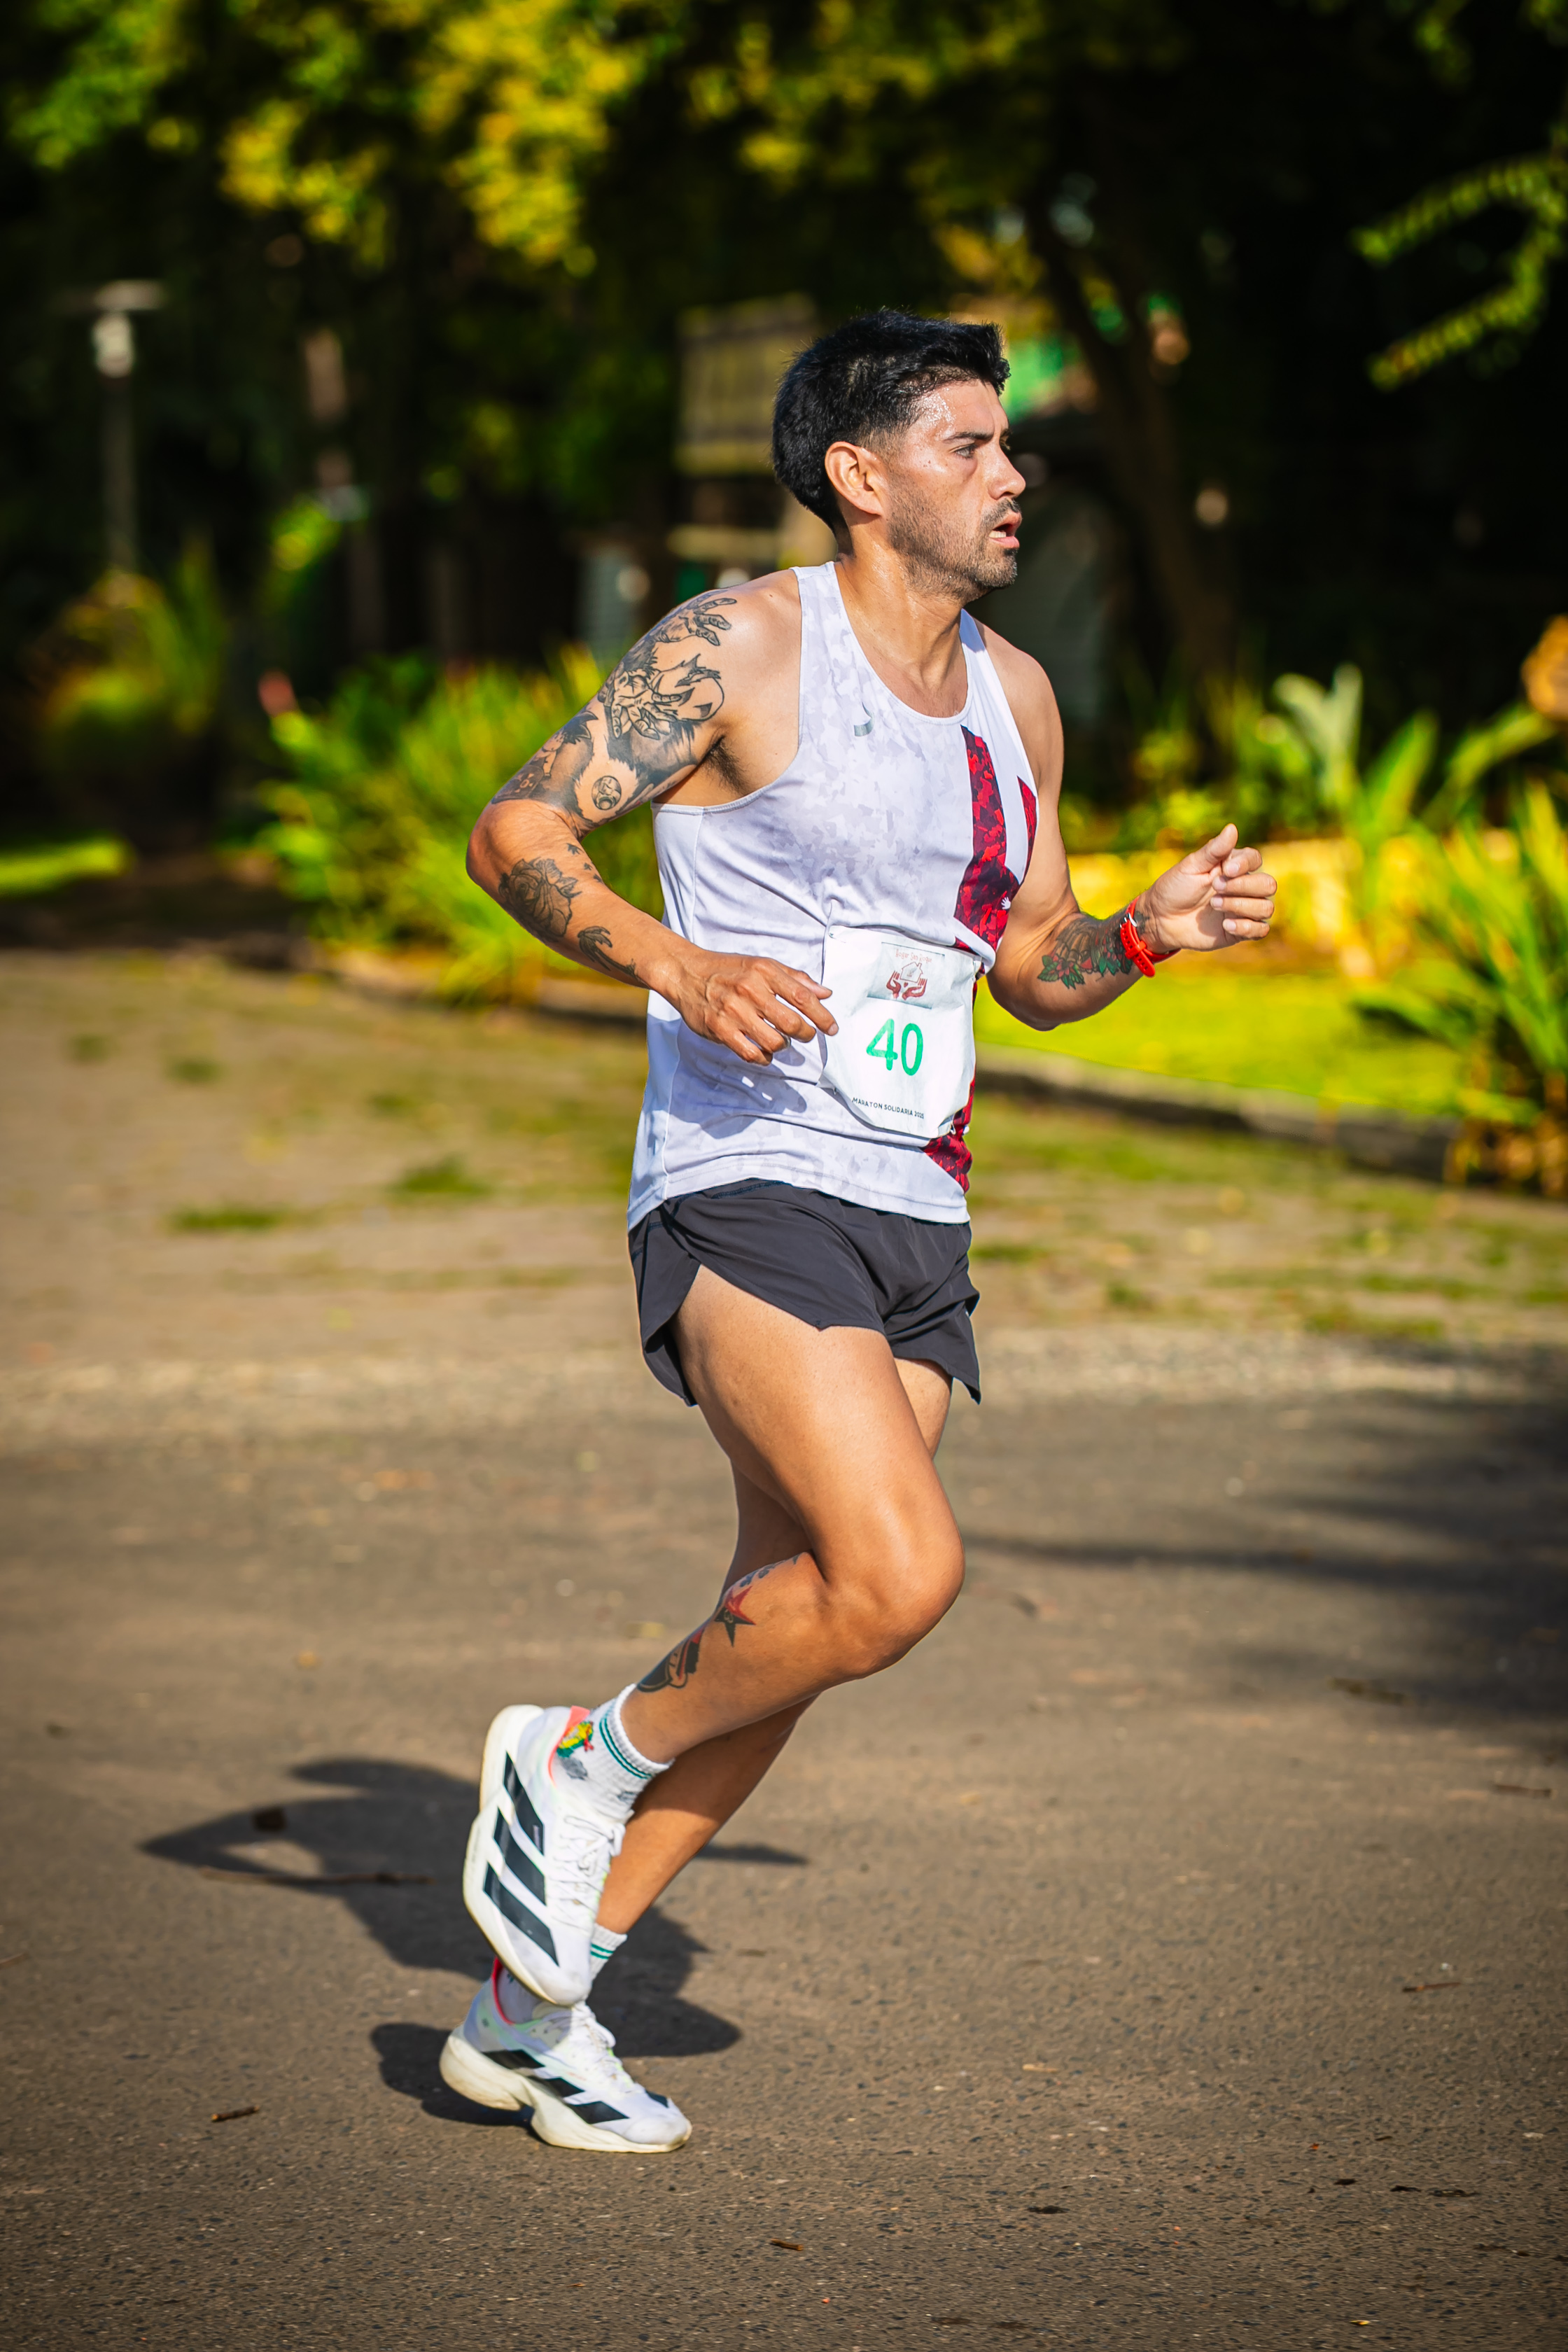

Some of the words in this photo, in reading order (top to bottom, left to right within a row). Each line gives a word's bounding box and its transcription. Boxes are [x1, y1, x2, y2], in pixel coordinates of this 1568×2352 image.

[919, 953, 932, 964] Roque
[866, 1018, 923, 1076] 40
[851, 1097, 883, 1110] MARATON
[883, 1104, 913, 1116] SOLIDARIA
[914, 1110, 925, 1119] 2025
